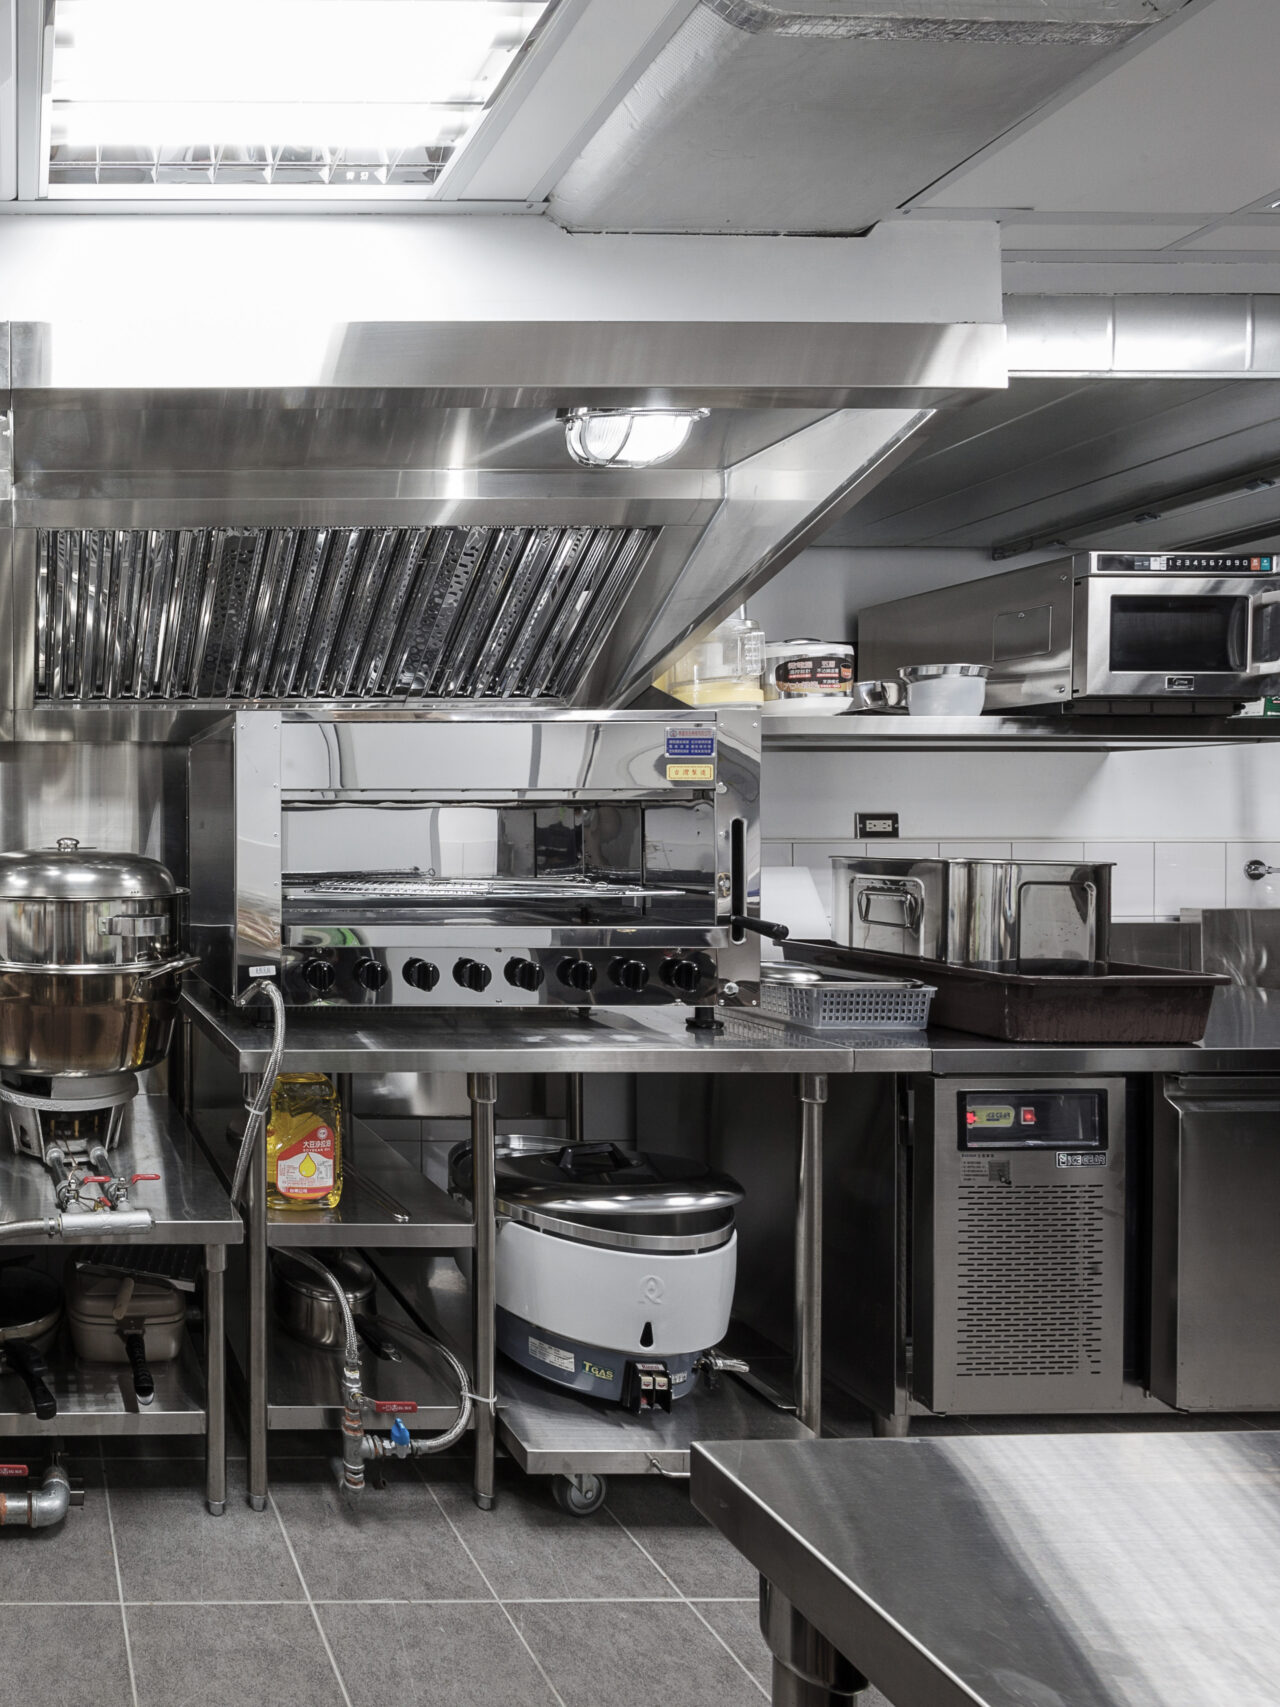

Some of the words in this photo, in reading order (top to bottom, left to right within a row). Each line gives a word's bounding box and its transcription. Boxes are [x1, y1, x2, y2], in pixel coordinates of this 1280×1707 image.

[303, 1140, 331, 1149] 大豆沙拉油
